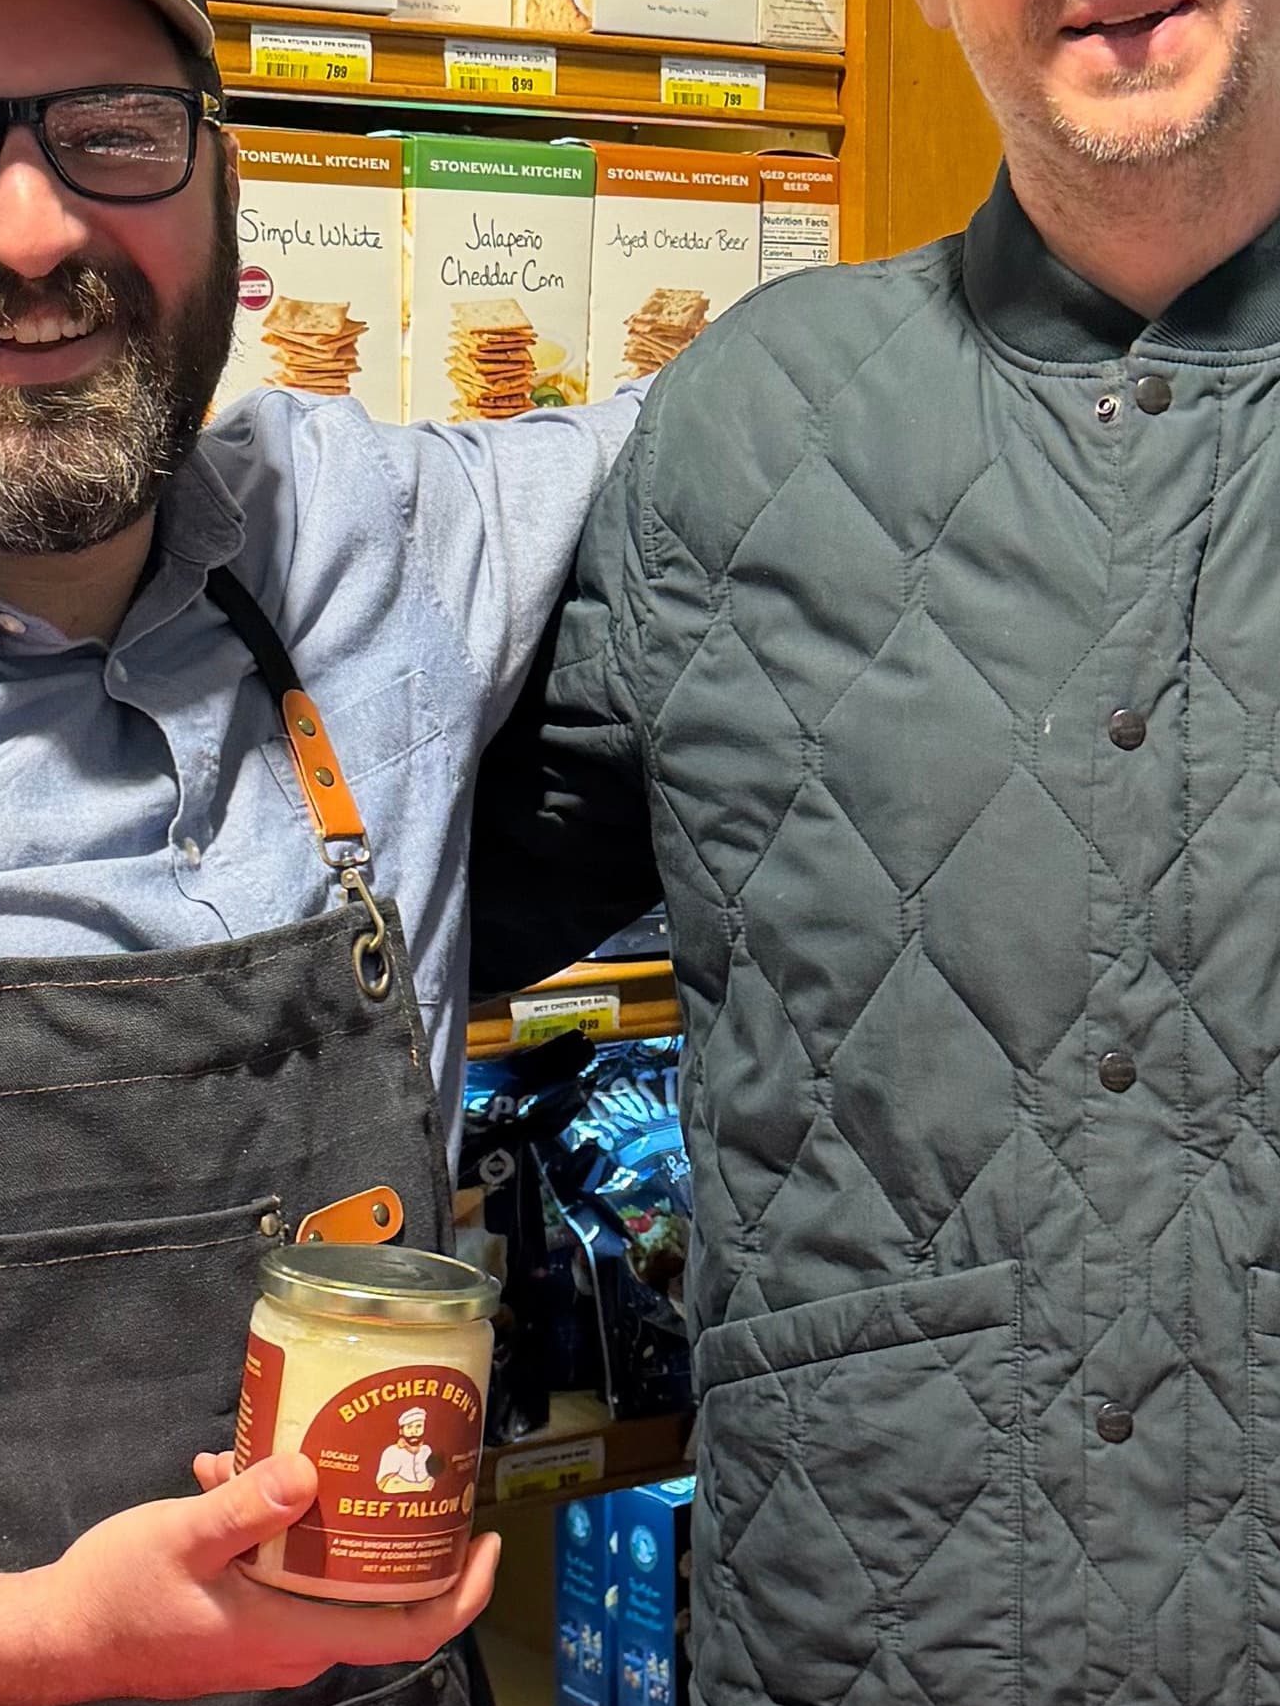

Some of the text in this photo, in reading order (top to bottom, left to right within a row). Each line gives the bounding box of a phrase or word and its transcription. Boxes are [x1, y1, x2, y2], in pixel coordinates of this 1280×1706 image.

[238, 209, 384, 250] Simple White
[465, 213, 543, 257] Jalapeño
[607, 221, 748, 257] Aged Cheddar Beer
[763, 216, 828, 227] Nutrition Facts
[440, 255, 565, 292] Cheddar Corn
[338, 1379, 438, 1423] BUTCHER
[338, 1497, 459, 1518] BEEF TALLOW
